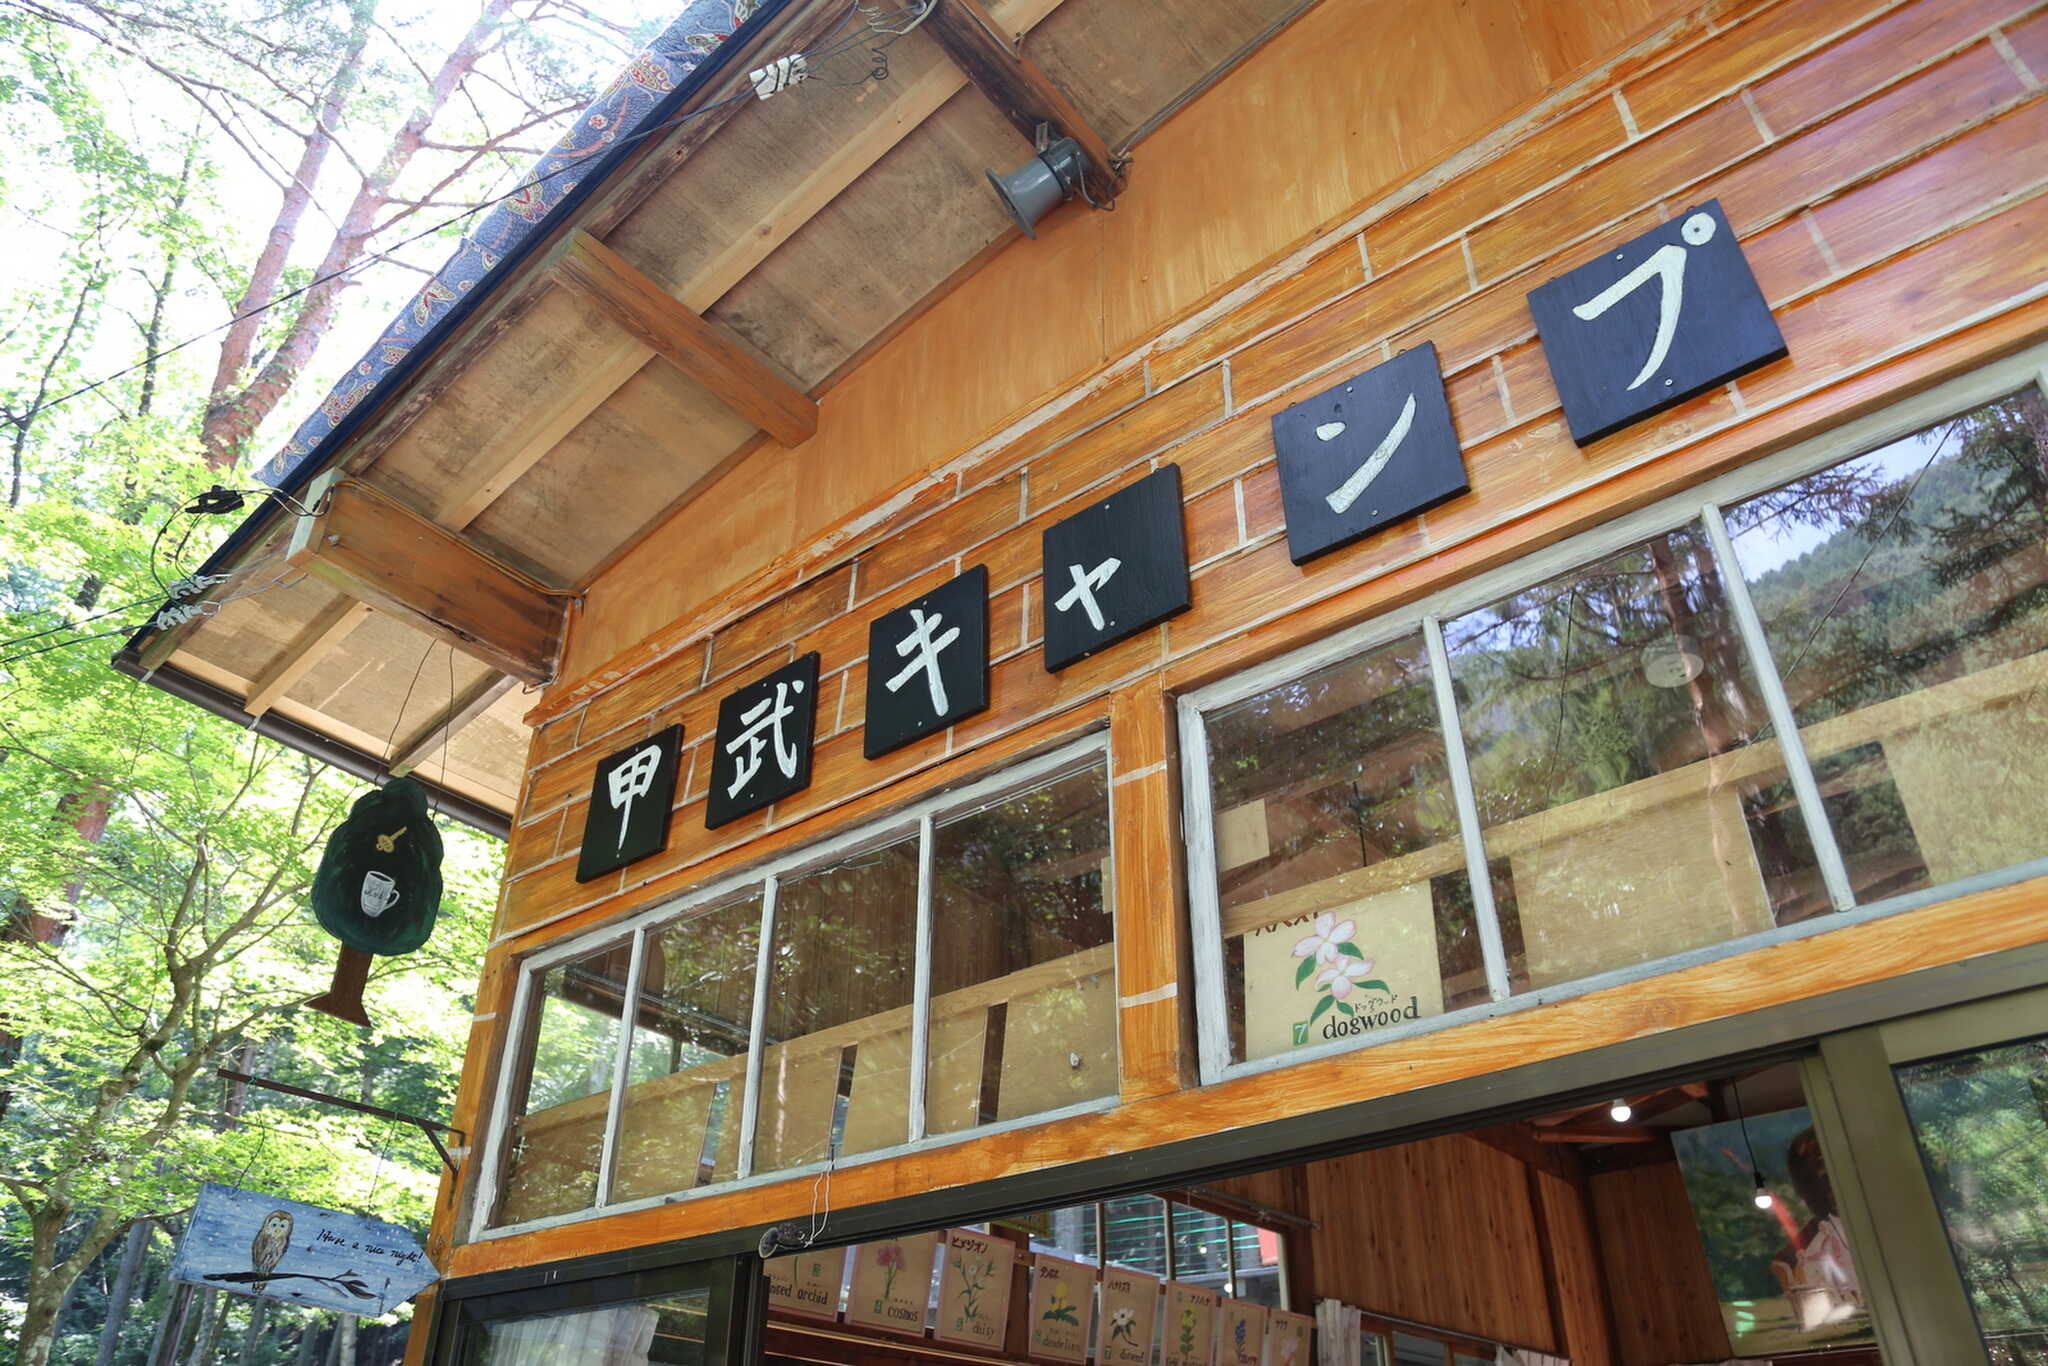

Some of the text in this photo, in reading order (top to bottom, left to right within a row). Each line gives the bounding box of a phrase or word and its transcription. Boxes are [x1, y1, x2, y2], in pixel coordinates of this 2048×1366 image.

[1294, 996, 1421, 1044] 7 dogwood
[364, 1244, 385, 1255] nice
[797, 1288, 829, 1305] orchid
